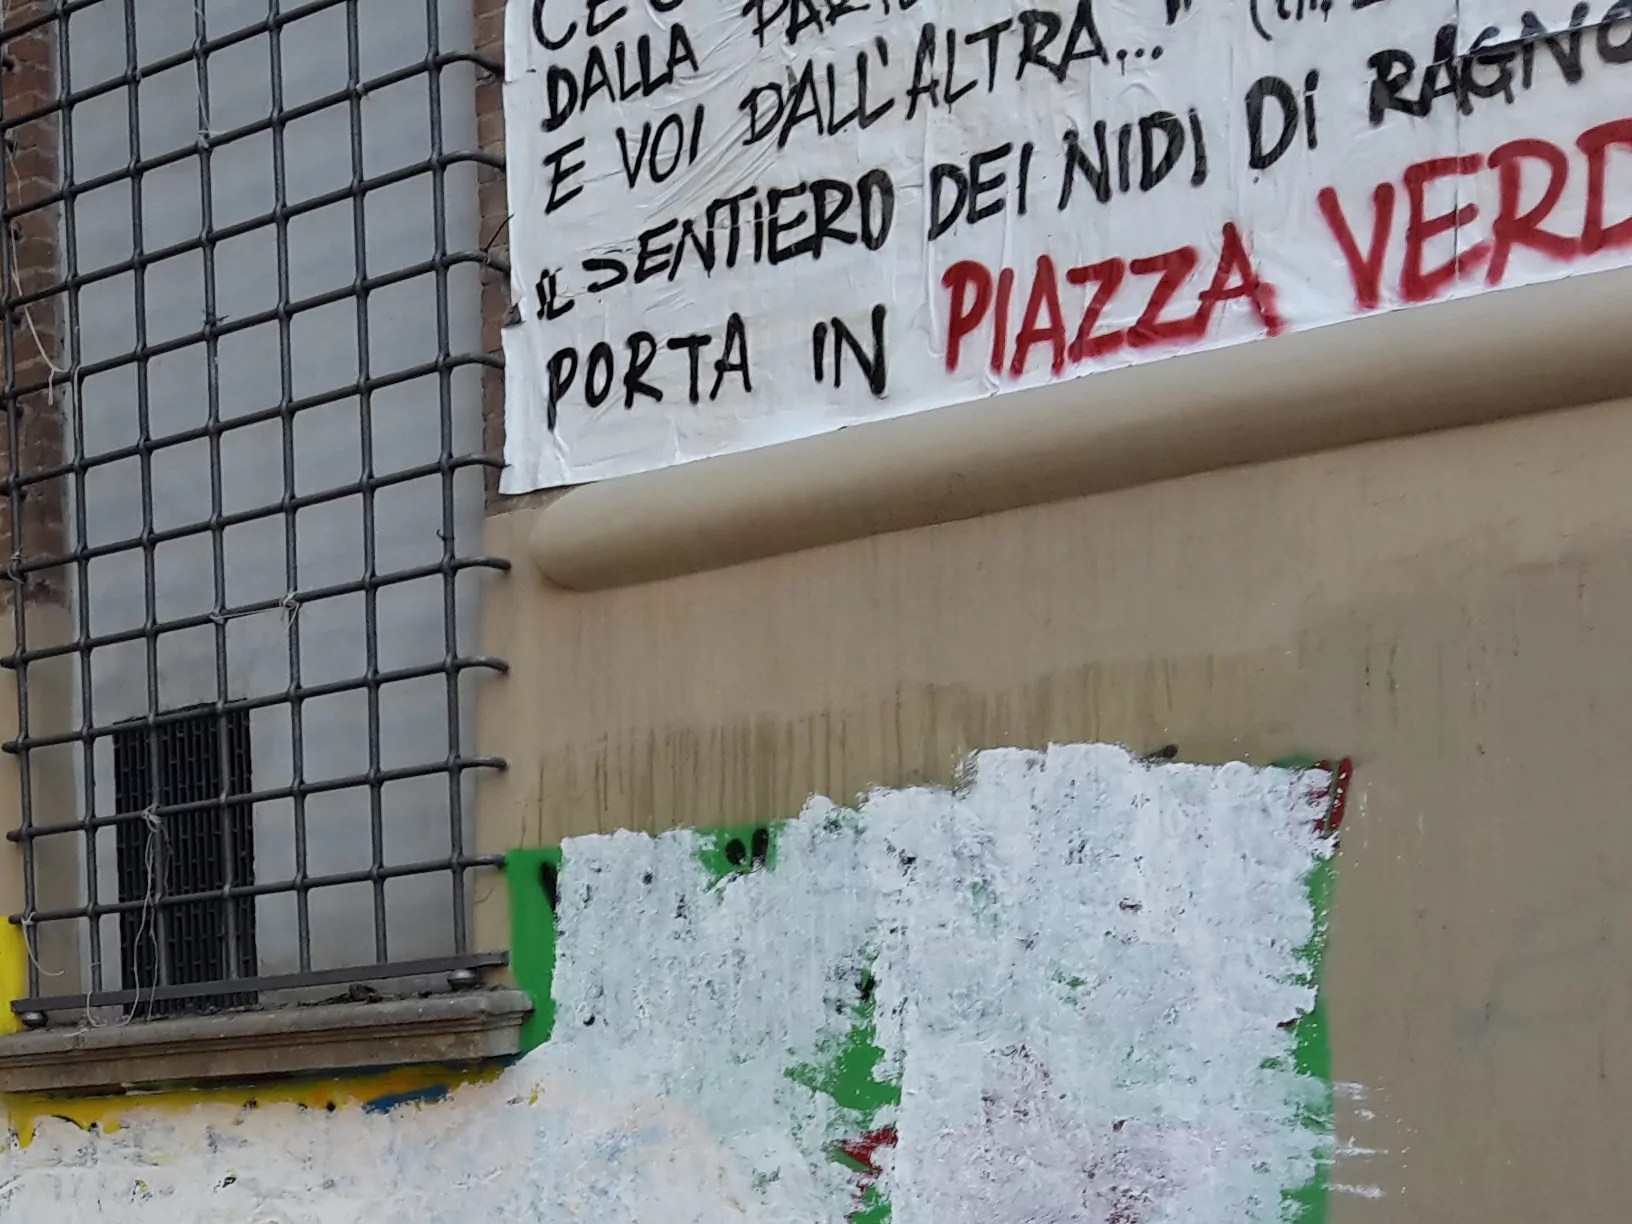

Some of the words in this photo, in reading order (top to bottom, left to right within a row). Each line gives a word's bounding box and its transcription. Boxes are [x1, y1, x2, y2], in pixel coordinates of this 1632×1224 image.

[541, 23, 699, 132] DALLA
[535, 268, 575, 321] IL
[582, 168, 895, 293] SENTIERO
[927, 142, 1034, 241] DEI
[1058, 107, 1208, 213] NIDI
[542, 137, 586, 215] E
[616, 103, 705, 189] VOI
[546, 312, 753, 431] PORTA
[813, 304, 887, 397] IN
[941, 221, 1286, 379] PIAZZA
